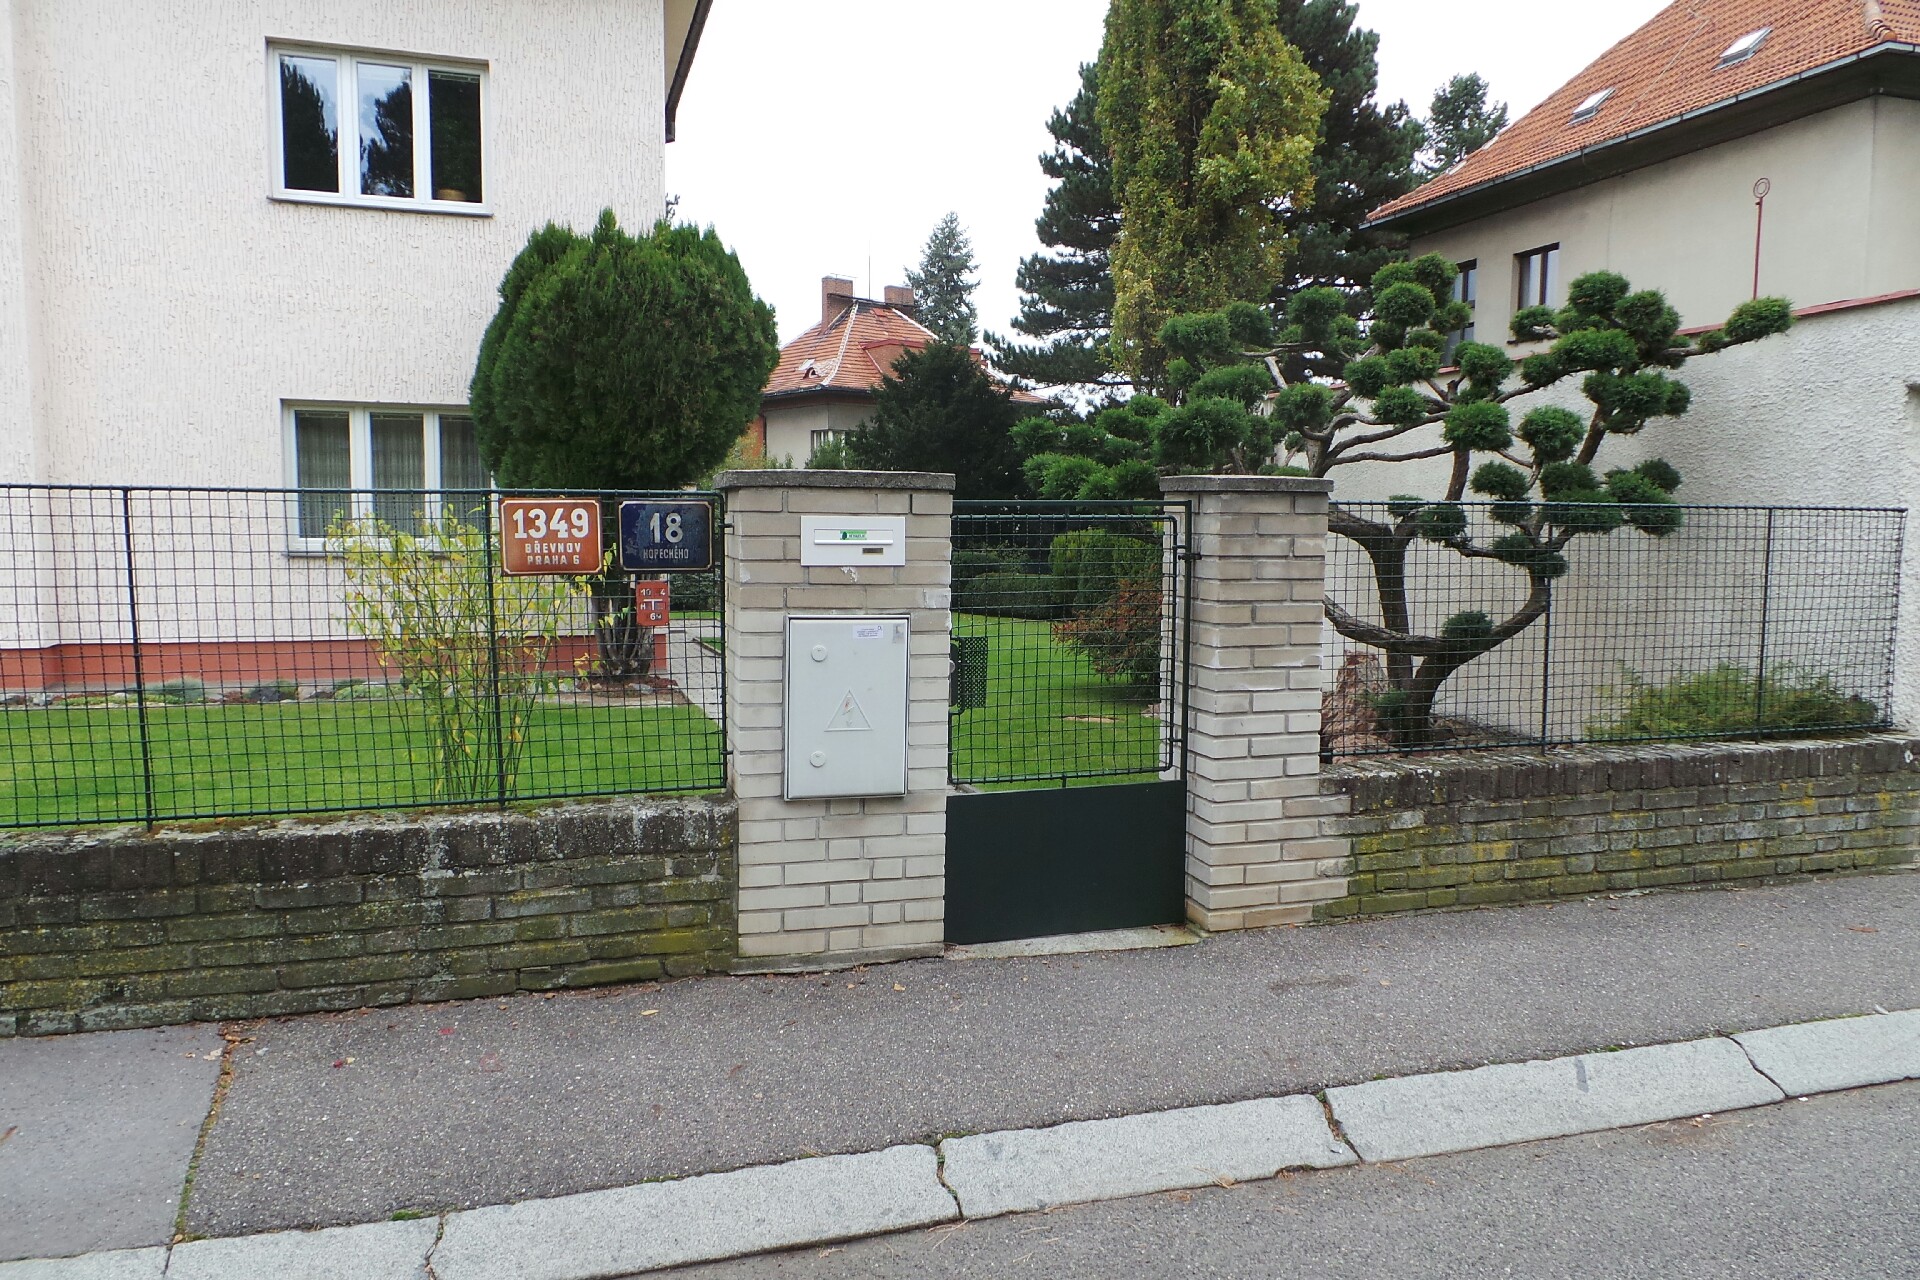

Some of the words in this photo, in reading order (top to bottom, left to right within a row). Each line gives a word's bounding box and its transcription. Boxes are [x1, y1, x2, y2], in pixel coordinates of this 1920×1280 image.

[512, 508, 589, 539] 1349
[650, 512, 683, 543] 18
[524, 540, 581, 553] BŘEVNOV
[643, 546, 689, 559] KOPECKÉHO
[527, 554, 567, 565] PRAHA
[573, 554, 580, 565] 6
